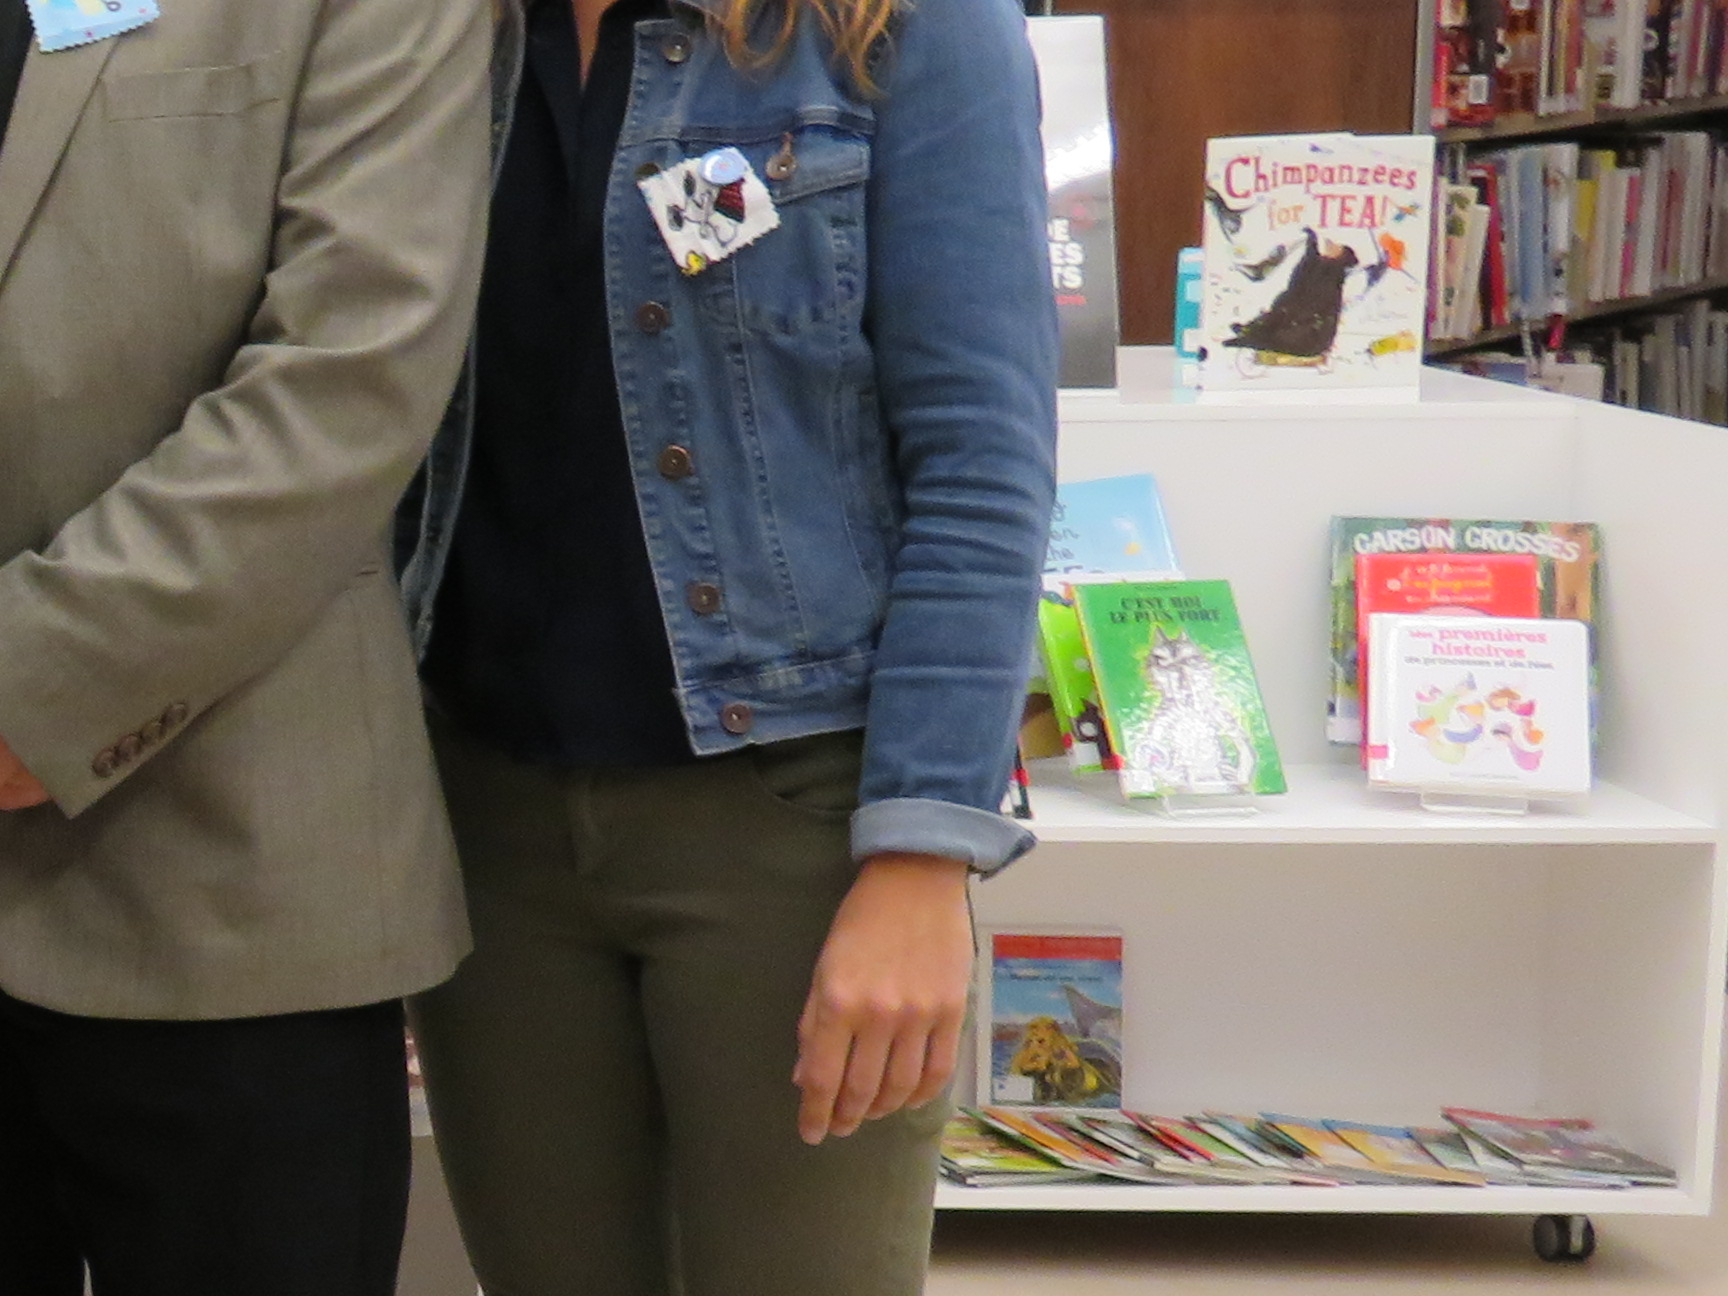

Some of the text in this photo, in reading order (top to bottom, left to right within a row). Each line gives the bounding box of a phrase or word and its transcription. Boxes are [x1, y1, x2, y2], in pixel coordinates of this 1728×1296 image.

[1225, 155, 1417, 199] Chimpanzees
[1268, 194, 1389, 230] for TEA!
[1354, 526, 1581, 562] CARSON CROSSES
[1432, 642, 1527, 658] histoires
